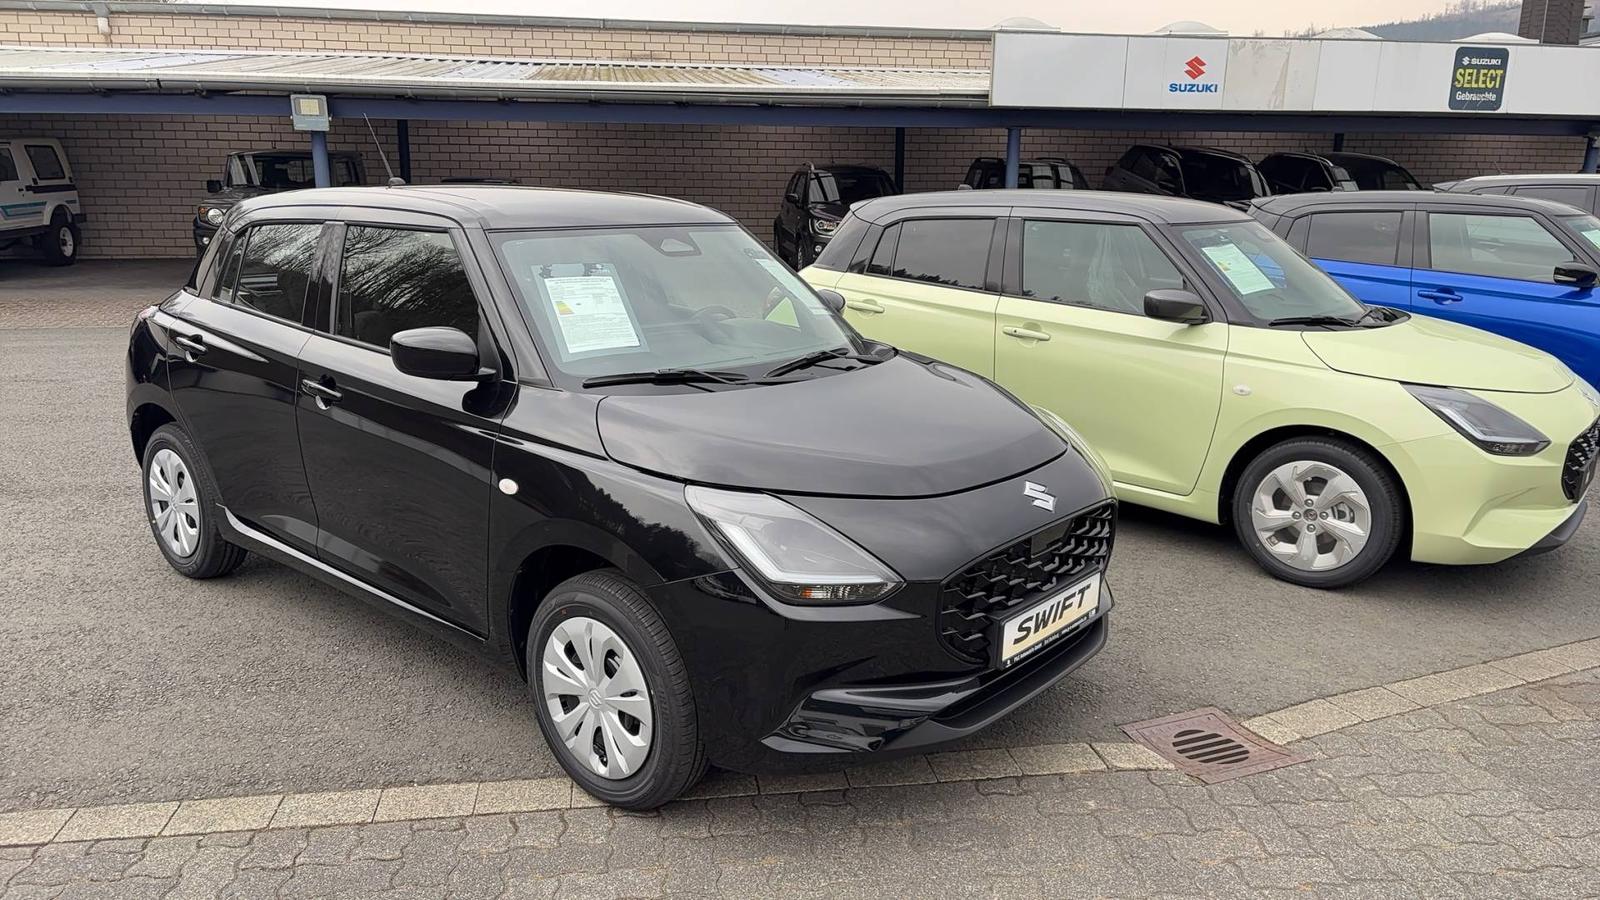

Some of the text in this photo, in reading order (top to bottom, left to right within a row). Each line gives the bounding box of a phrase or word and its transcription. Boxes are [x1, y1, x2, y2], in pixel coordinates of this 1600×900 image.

[1455, 68, 1504, 88] SELECT
[1169, 83, 1218, 93] SUZUKI
[1456, 91, 1496, 101] Gebrauchte
[1012, 583, 1091, 645] SWIFT
